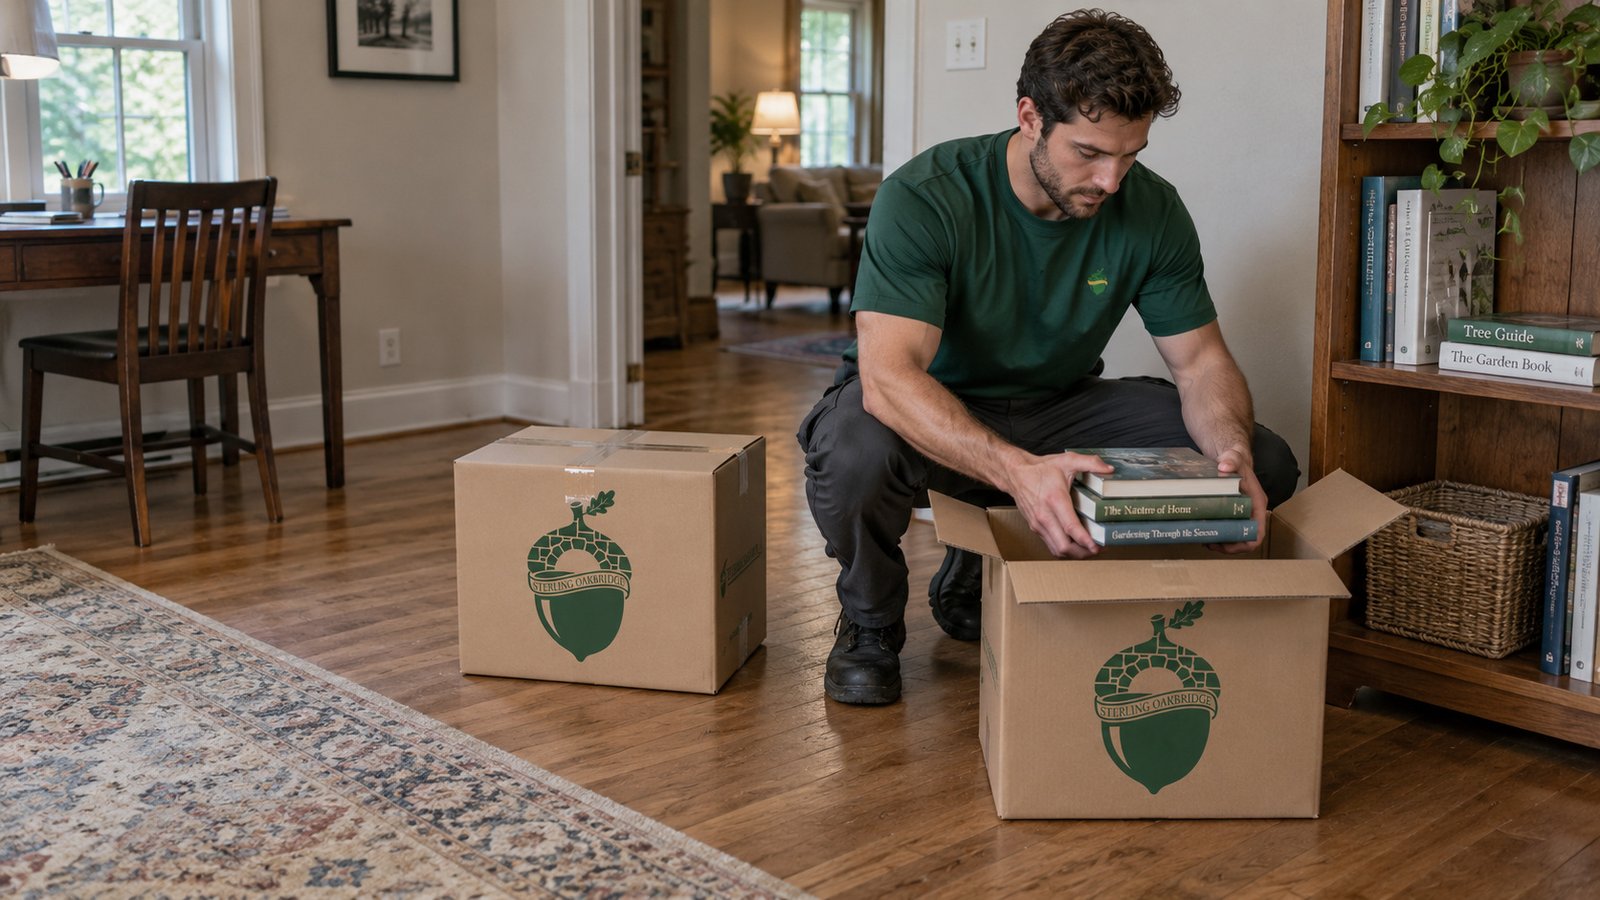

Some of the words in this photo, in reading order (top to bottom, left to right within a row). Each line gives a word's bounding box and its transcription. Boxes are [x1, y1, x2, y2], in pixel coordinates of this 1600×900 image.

[1463, 324, 1492, 339] Tree
[1495, 327, 1534, 344] Guide
[1451, 350, 1473, 364] The
[1476, 353, 1518, 369] Garden
[1522, 358, 1552, 373] Book
[1156, 504, 1166, 514] of
[532, 579, 574, 593] STERLING
[575, 573, 626, 588] OAKBRIDGE
[1100, 701, 1150, 718] STERLING
[1152, 692, 1212, 710] OAKBRIDGE
